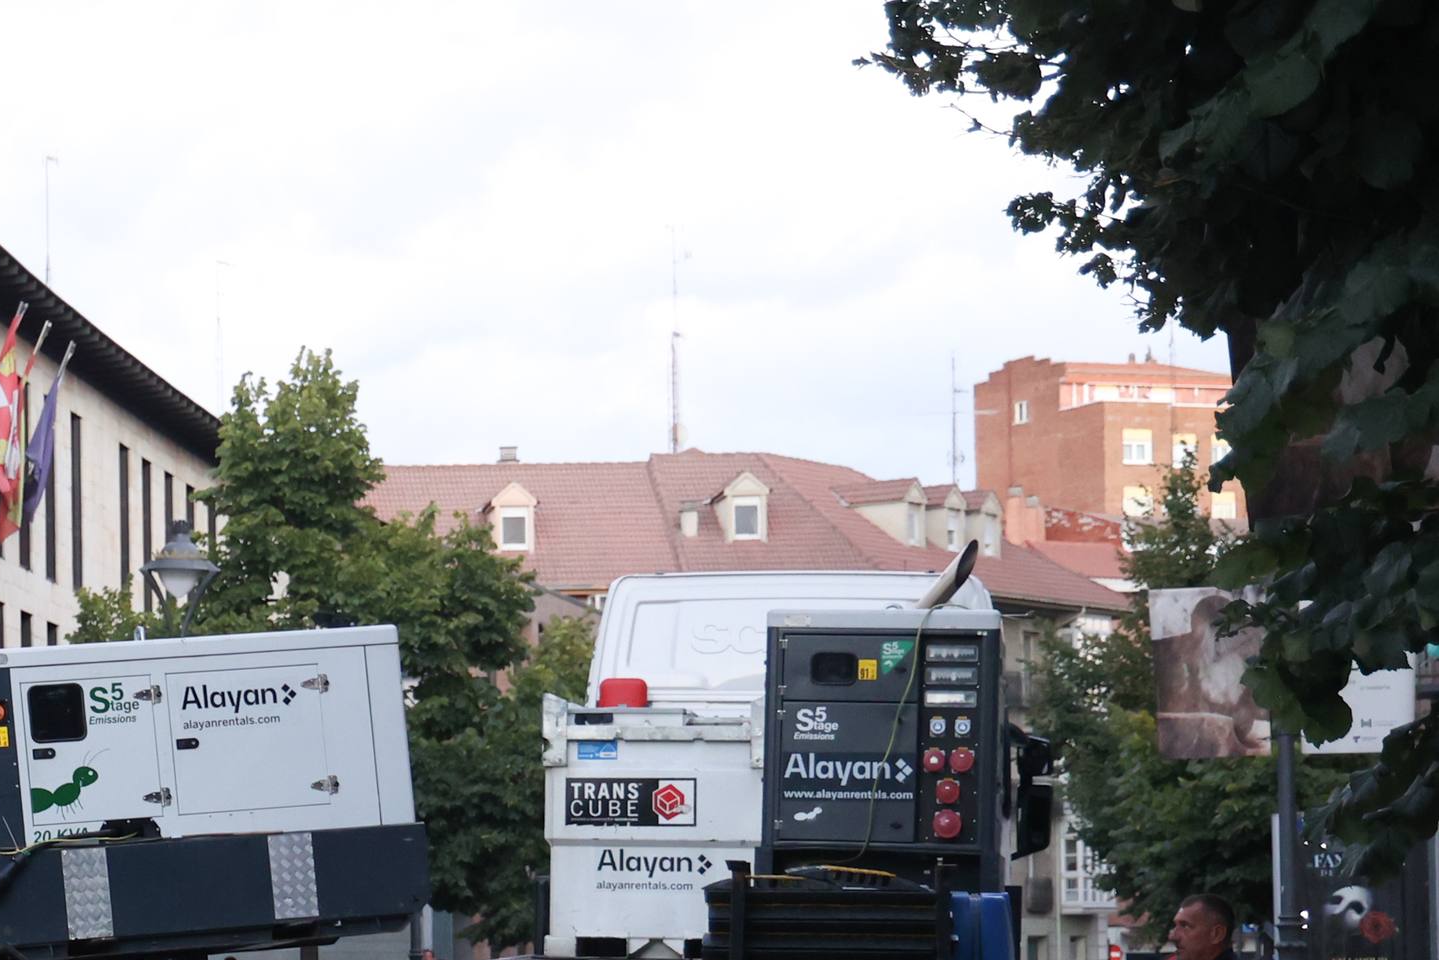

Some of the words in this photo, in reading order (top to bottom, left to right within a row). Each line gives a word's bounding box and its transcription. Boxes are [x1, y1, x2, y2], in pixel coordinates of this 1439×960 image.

[181, 684, 278, 713] Alayan
[89, 715, 137, 725] Emissions
[183, 715, 281, 731] alayanrentals.com
[793, 731, 835, 741] Emissions
[783, 752, 891, 786] Alayan
[570, 782, 639, 799] TRANS
[570, 800, 639, 817] CUBE
[597, 848, 692, 878] Alayan
[596, 880, 693, 892] alayanrentals.com
